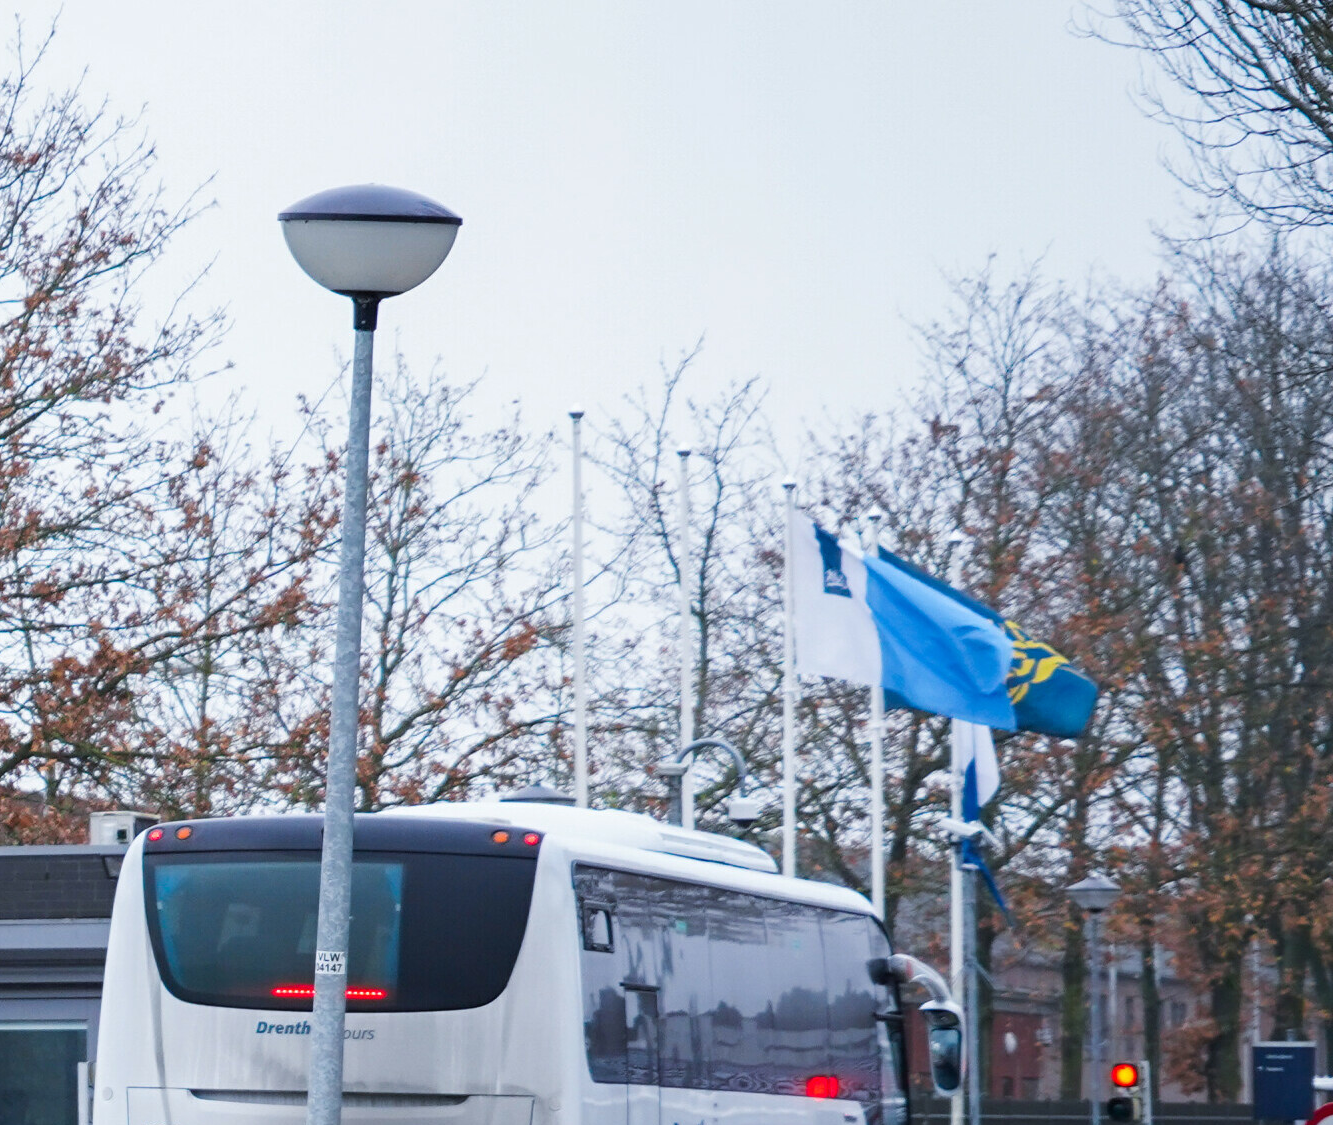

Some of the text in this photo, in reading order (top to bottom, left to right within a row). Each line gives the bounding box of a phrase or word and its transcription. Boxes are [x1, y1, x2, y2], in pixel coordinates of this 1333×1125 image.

[318, 952, 341, 962] VLW
[256, 1020, 375, 1040] Drenth ours
